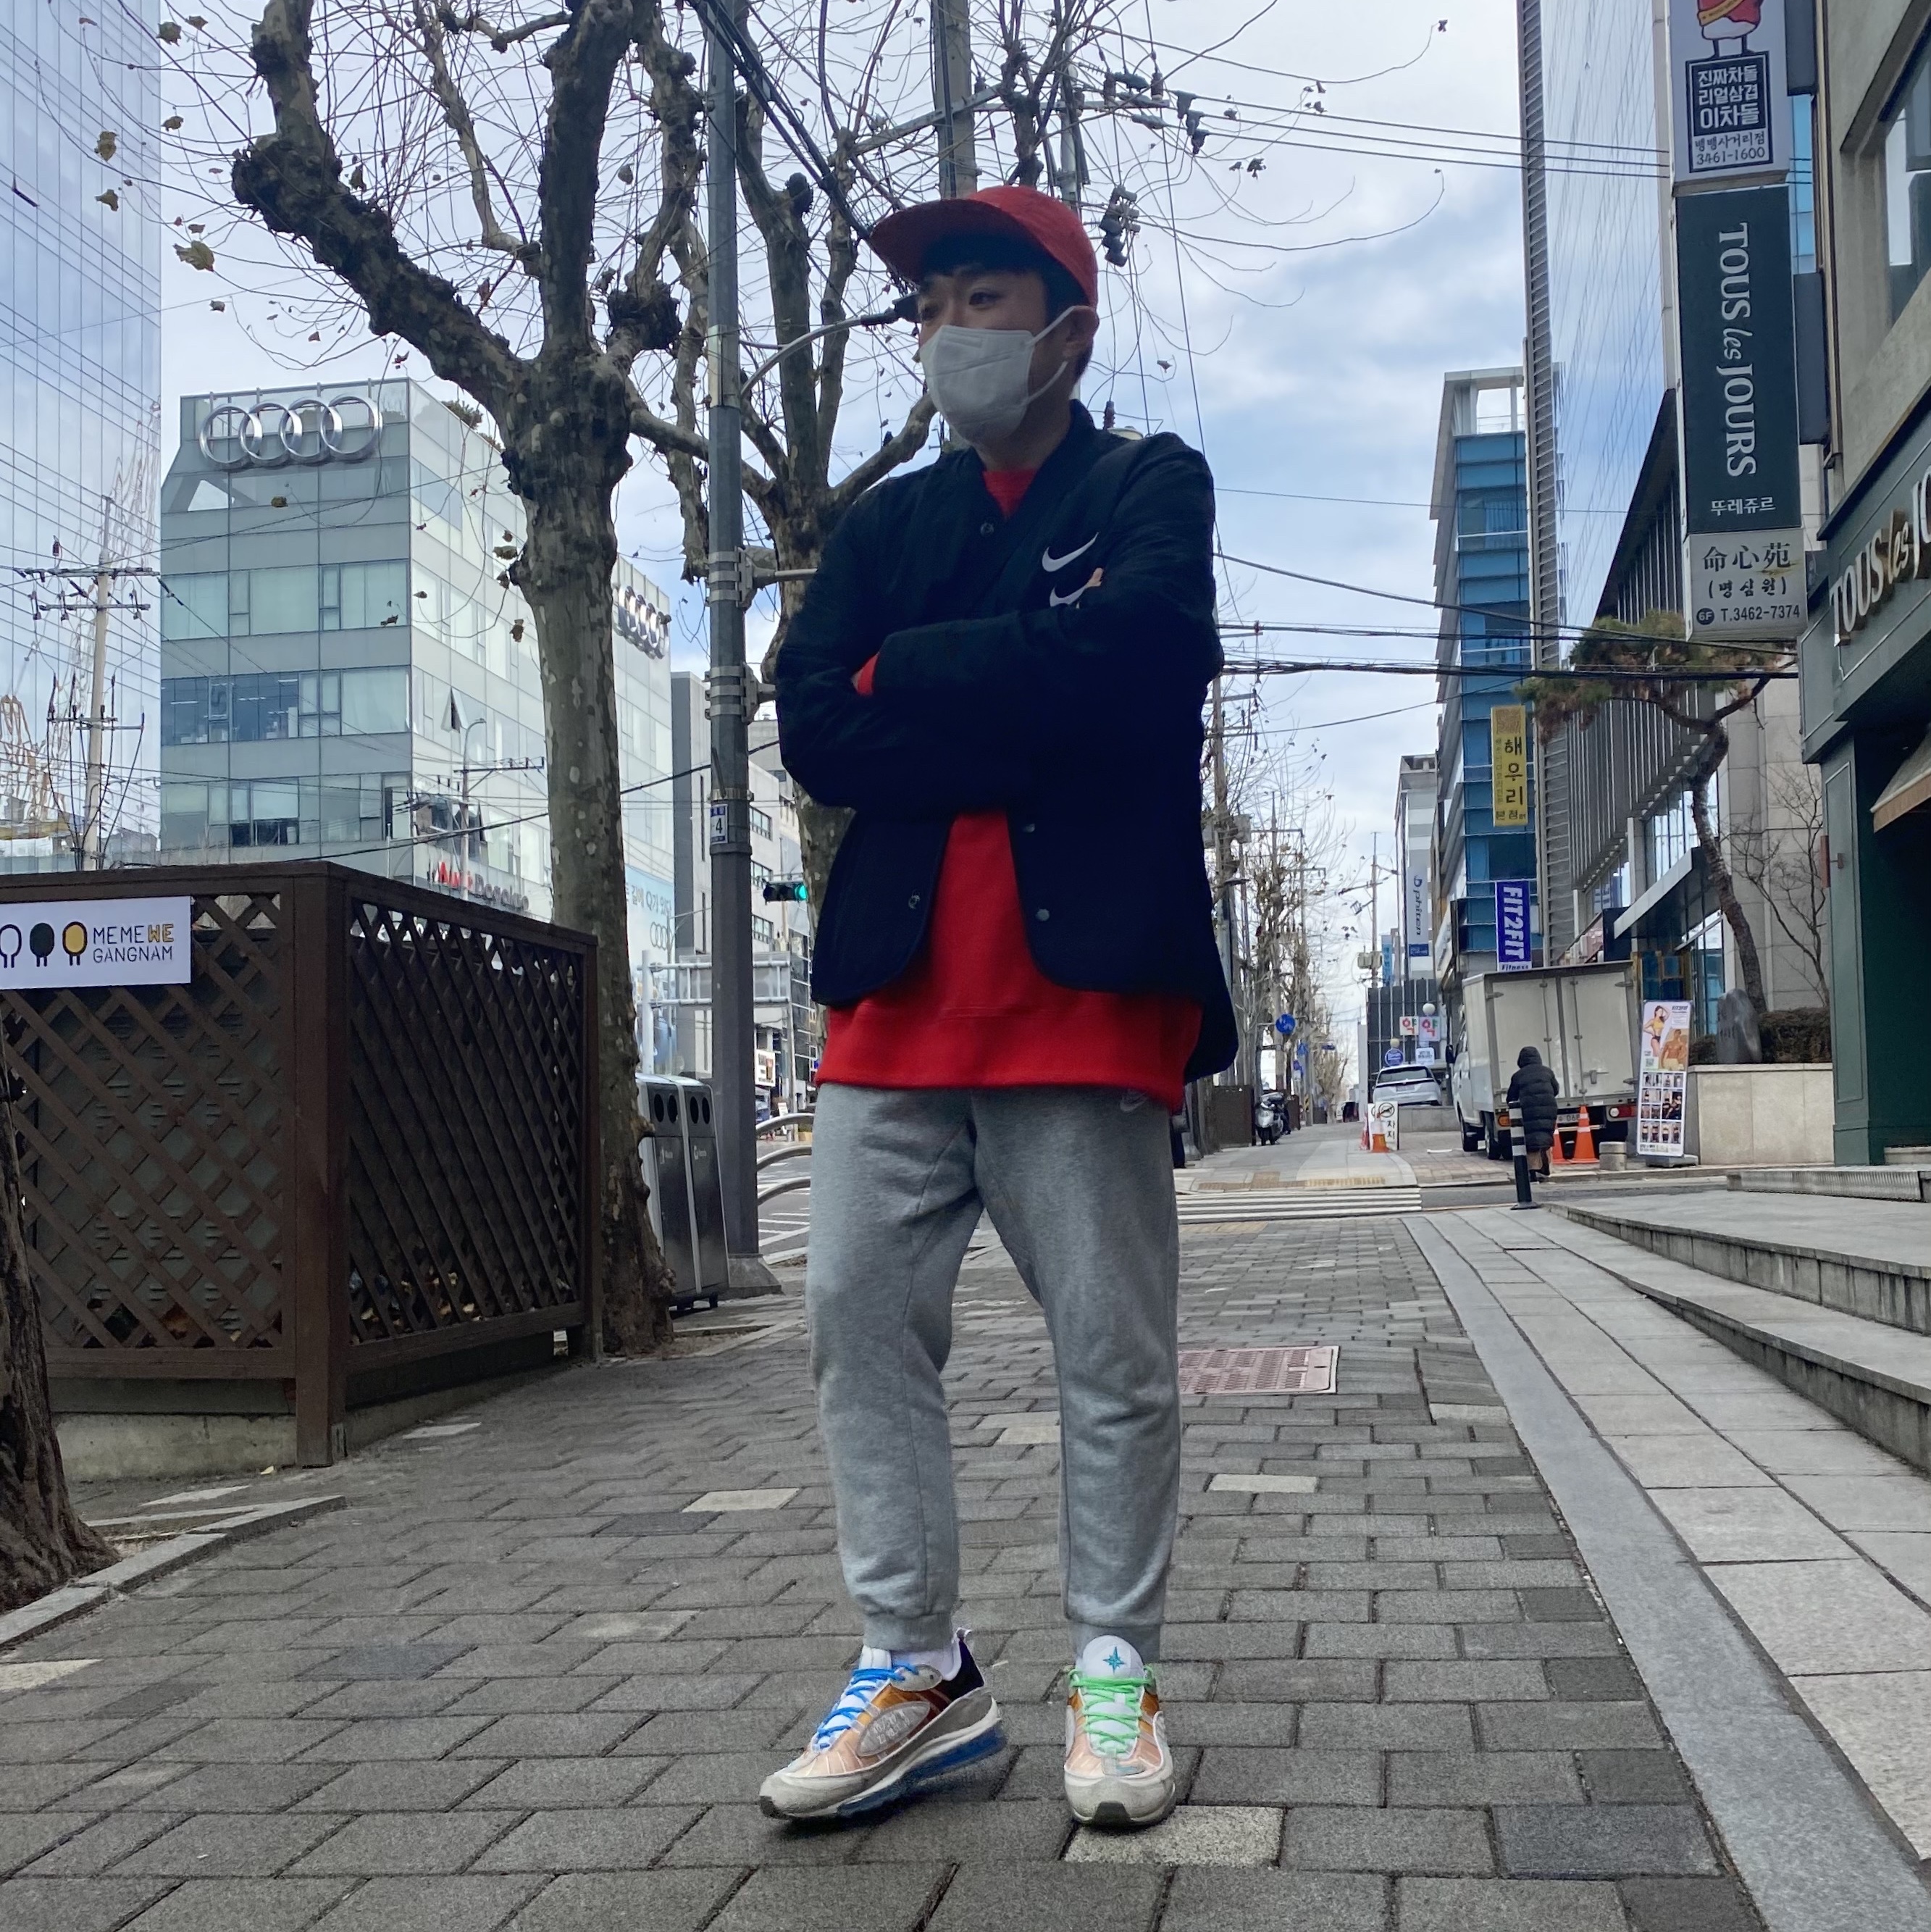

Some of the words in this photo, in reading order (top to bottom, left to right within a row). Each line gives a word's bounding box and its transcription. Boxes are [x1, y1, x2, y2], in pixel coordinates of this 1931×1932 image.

[1698, 64, 1758, 88] 진짜차돌
[1698, 83, 1759, 106] 리얼삼겹
[1700, 102, 1760, 129] 이차돌
[1696, 146, 1766, 166] 3461-1600
[1719, 222, 1751, 321] TOUS
[1723, 327, 1754, 360] les
[1716, 363, 1757, 477] JOURS
[1710, 496, 1777, 517] 뚜레쥬르
[1702, 541, 1792, 572] 命心苑
[1830, 528, 1883, 647] TOUS
[1888, 509, 1909, 585] les
[1698, 611, 1713, 622] 6F
[1720, 604, 1801, 622] T.3462-7374
[1504, 736, 1523, 806] 해우리
[1503, 886, 1525, 960] FIT2FIT
[93, 945, 173, 963] GANGNAM
